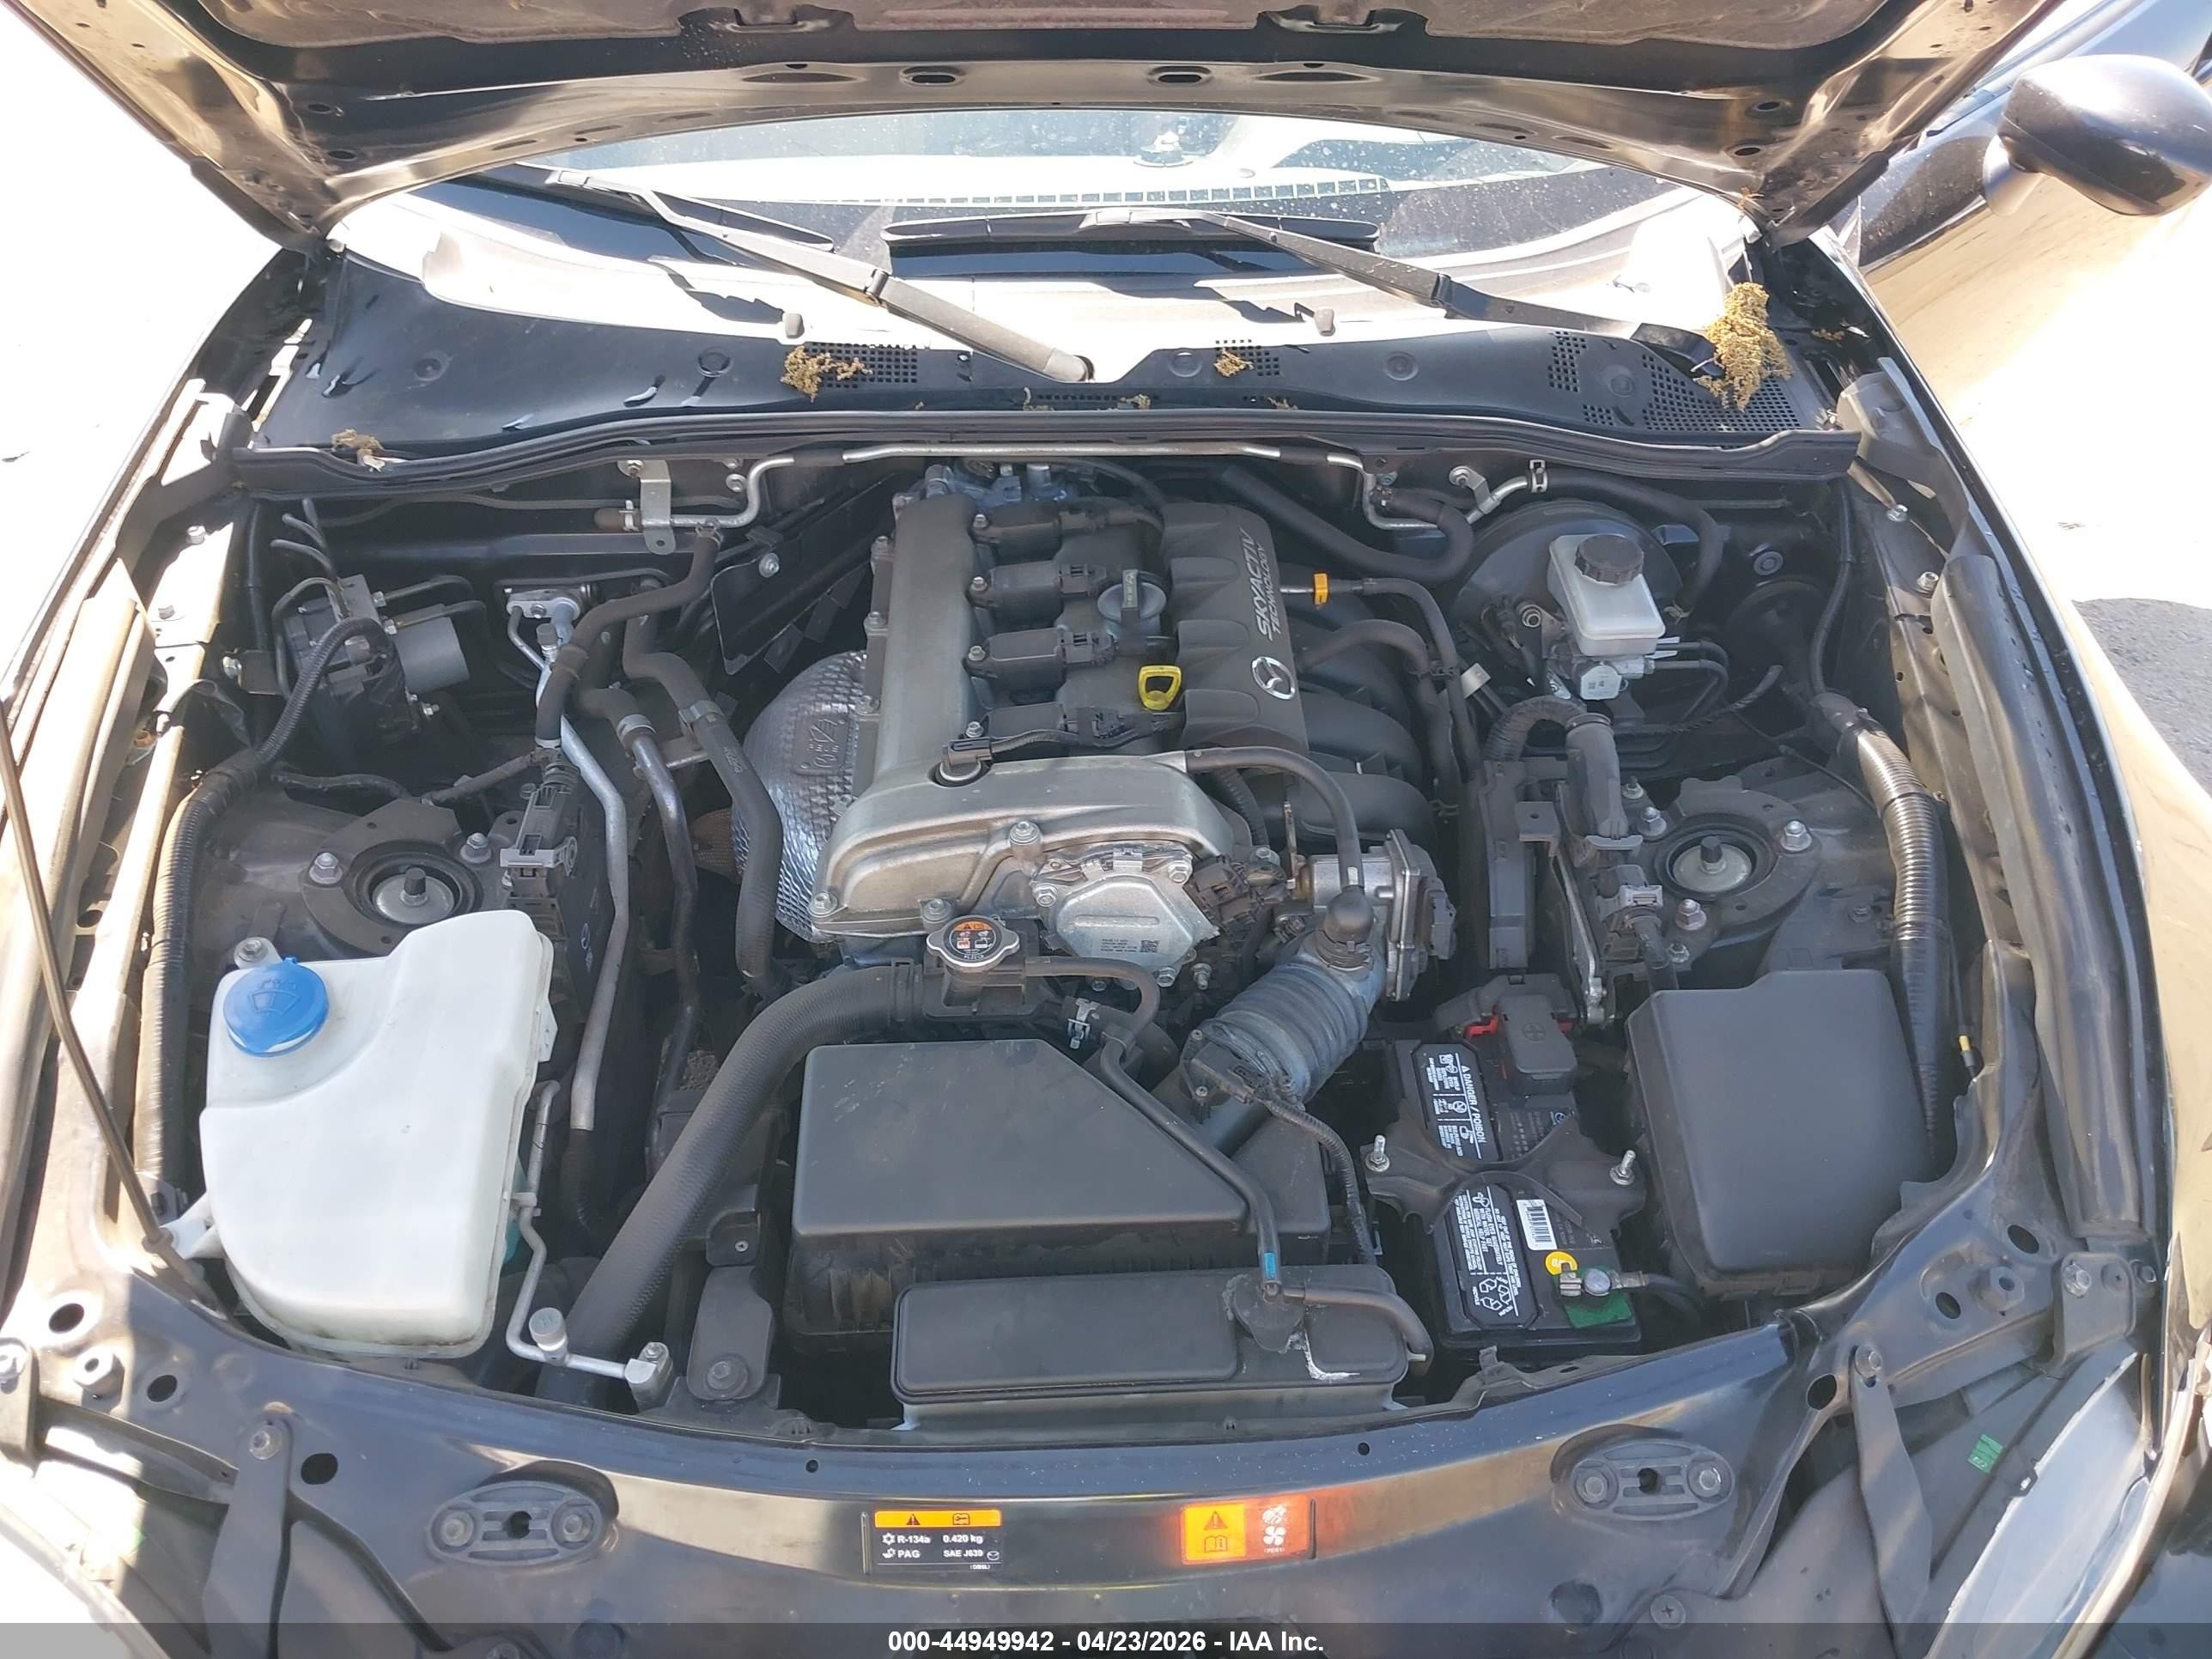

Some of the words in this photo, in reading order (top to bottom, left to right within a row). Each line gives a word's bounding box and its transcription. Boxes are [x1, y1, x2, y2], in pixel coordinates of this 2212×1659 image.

[1239, 527, 1273, 641] SKYACTIV
[1257, 543, 1282, 635] TECHNOLOGY
[1462, 1073, 1477, 1104] DANGER
[1471, 1113, 1486, 1142] POISON
[896, 1534, 931, 1545] R-134a
[942, 1534, 969, 1544] 0.420
[970, 1534, 983, 1545] kg
[897, 1549, 921, 1559] PAG
[943, 1549, 962, 1558] SAE
[963, 1549, 984, 1558] J639
